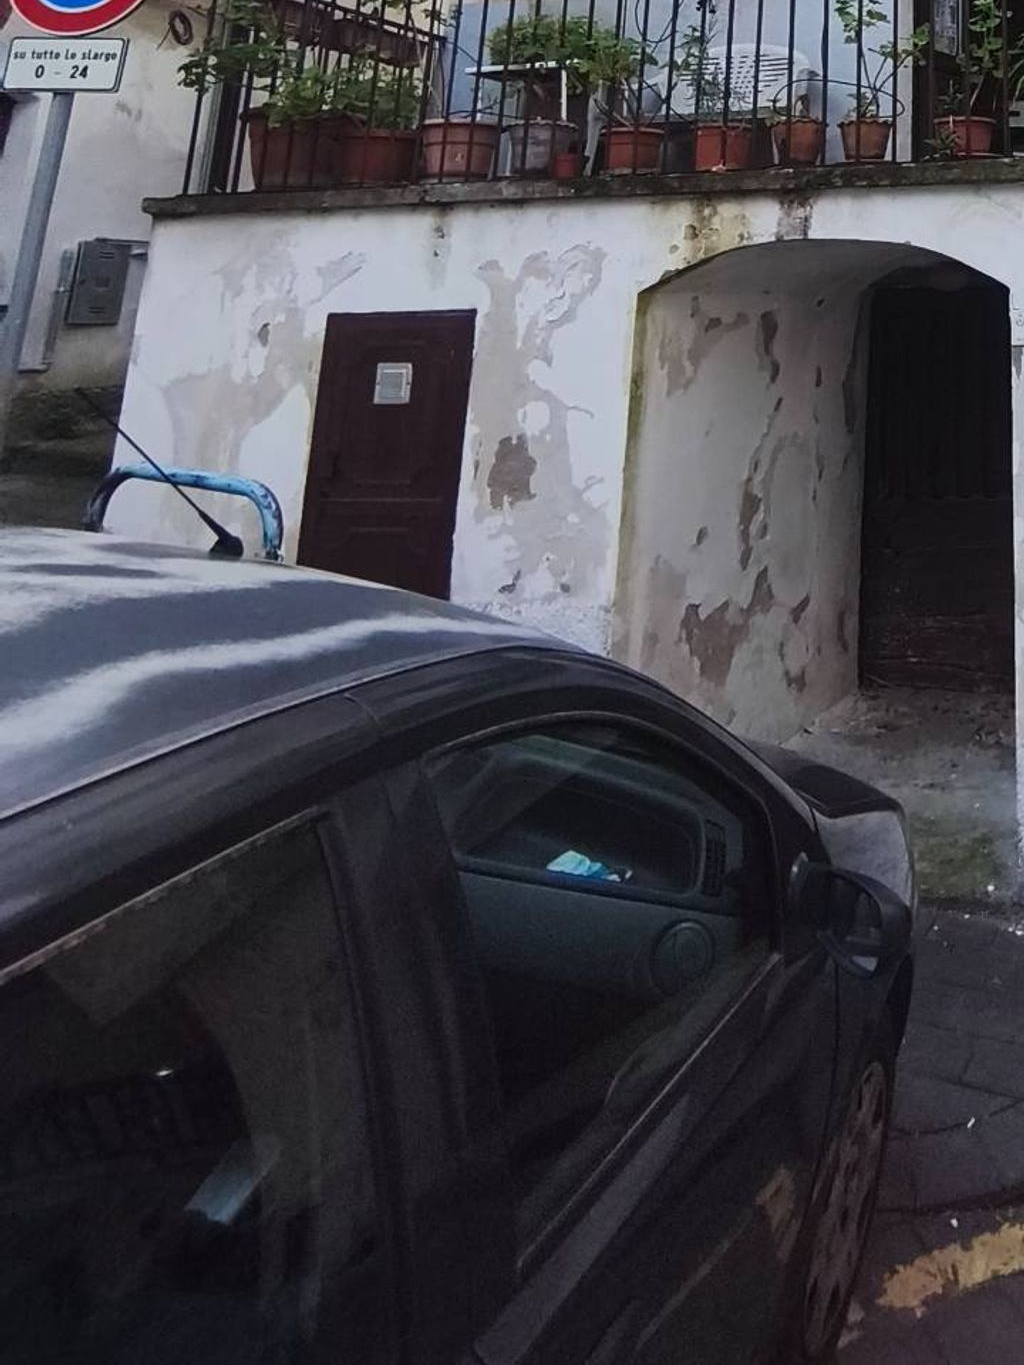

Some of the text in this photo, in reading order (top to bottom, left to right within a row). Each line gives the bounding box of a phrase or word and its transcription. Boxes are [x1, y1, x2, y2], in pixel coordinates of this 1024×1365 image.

[13, 51, 26, 60] su
[31, 49, 60, 60] tutto
[81, 49, 117, 62] slargo
[35, 64, 45, 79] 0
[69, 65, 89, 79] 24
